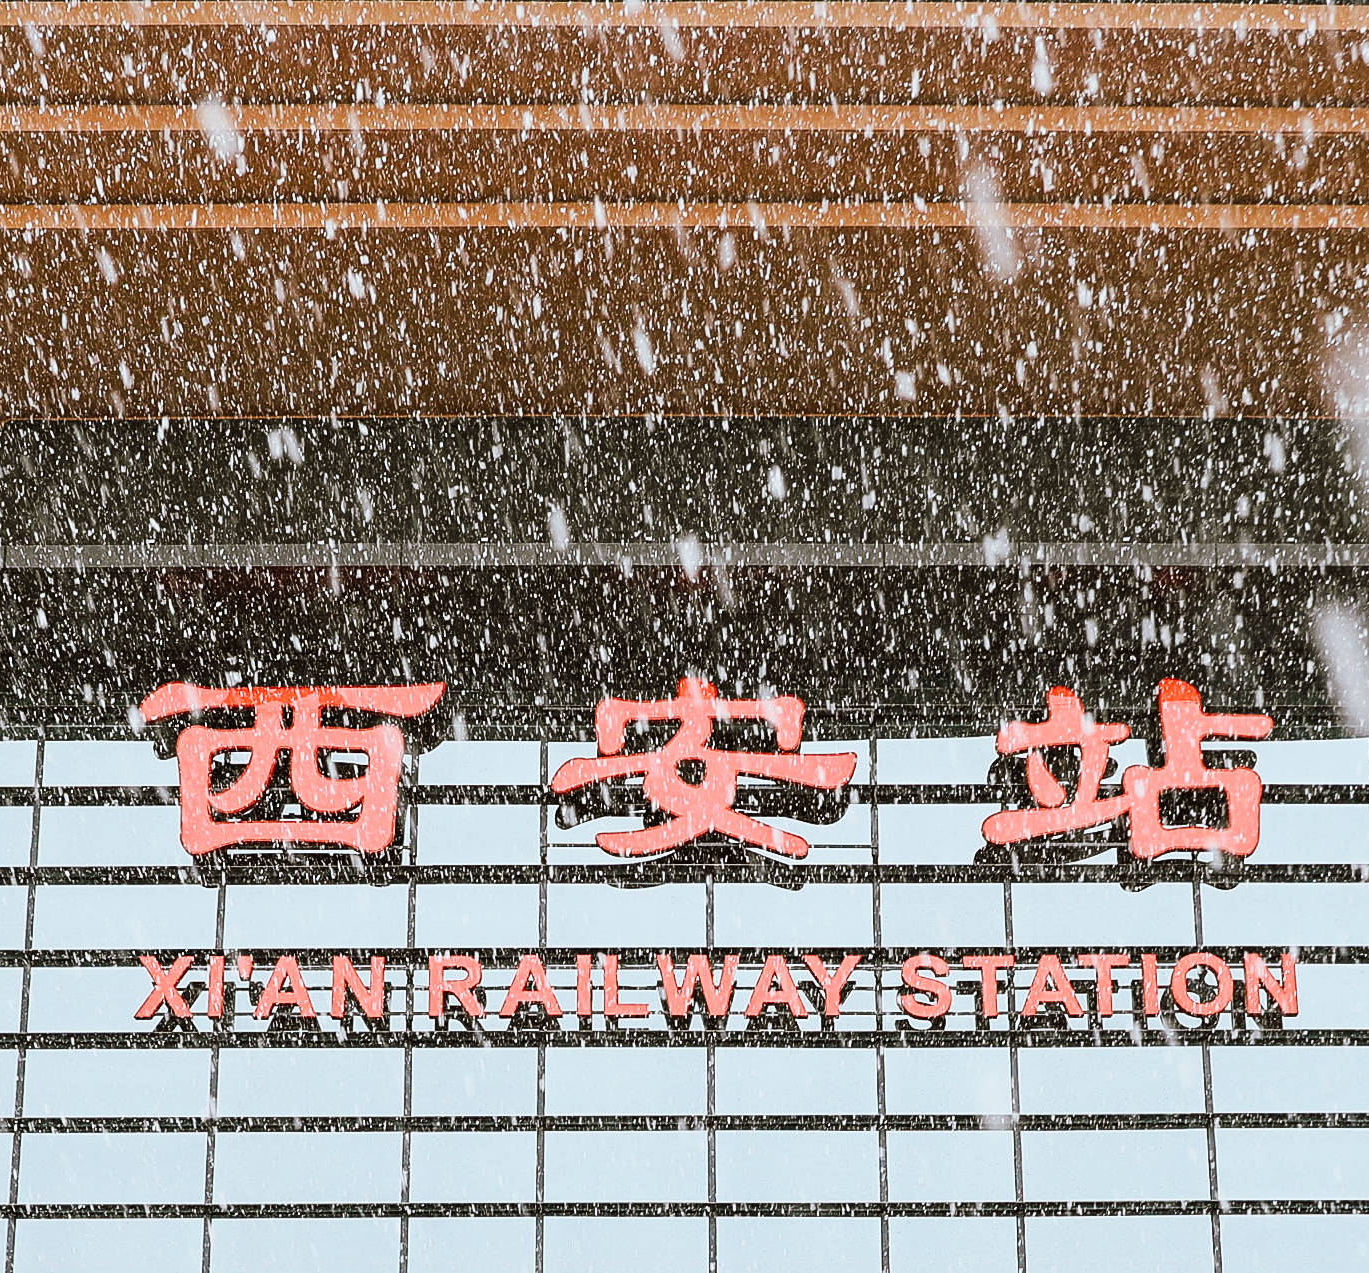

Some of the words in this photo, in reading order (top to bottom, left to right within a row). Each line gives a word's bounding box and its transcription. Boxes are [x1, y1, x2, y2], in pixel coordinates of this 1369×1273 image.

[140, 676, 1274, 861] 西安站
[134, 955, 386, 1020] XI'AN
[430, 953, 863, 1019] RAILWAY
[899, 952, 1299, 1021] STATION
